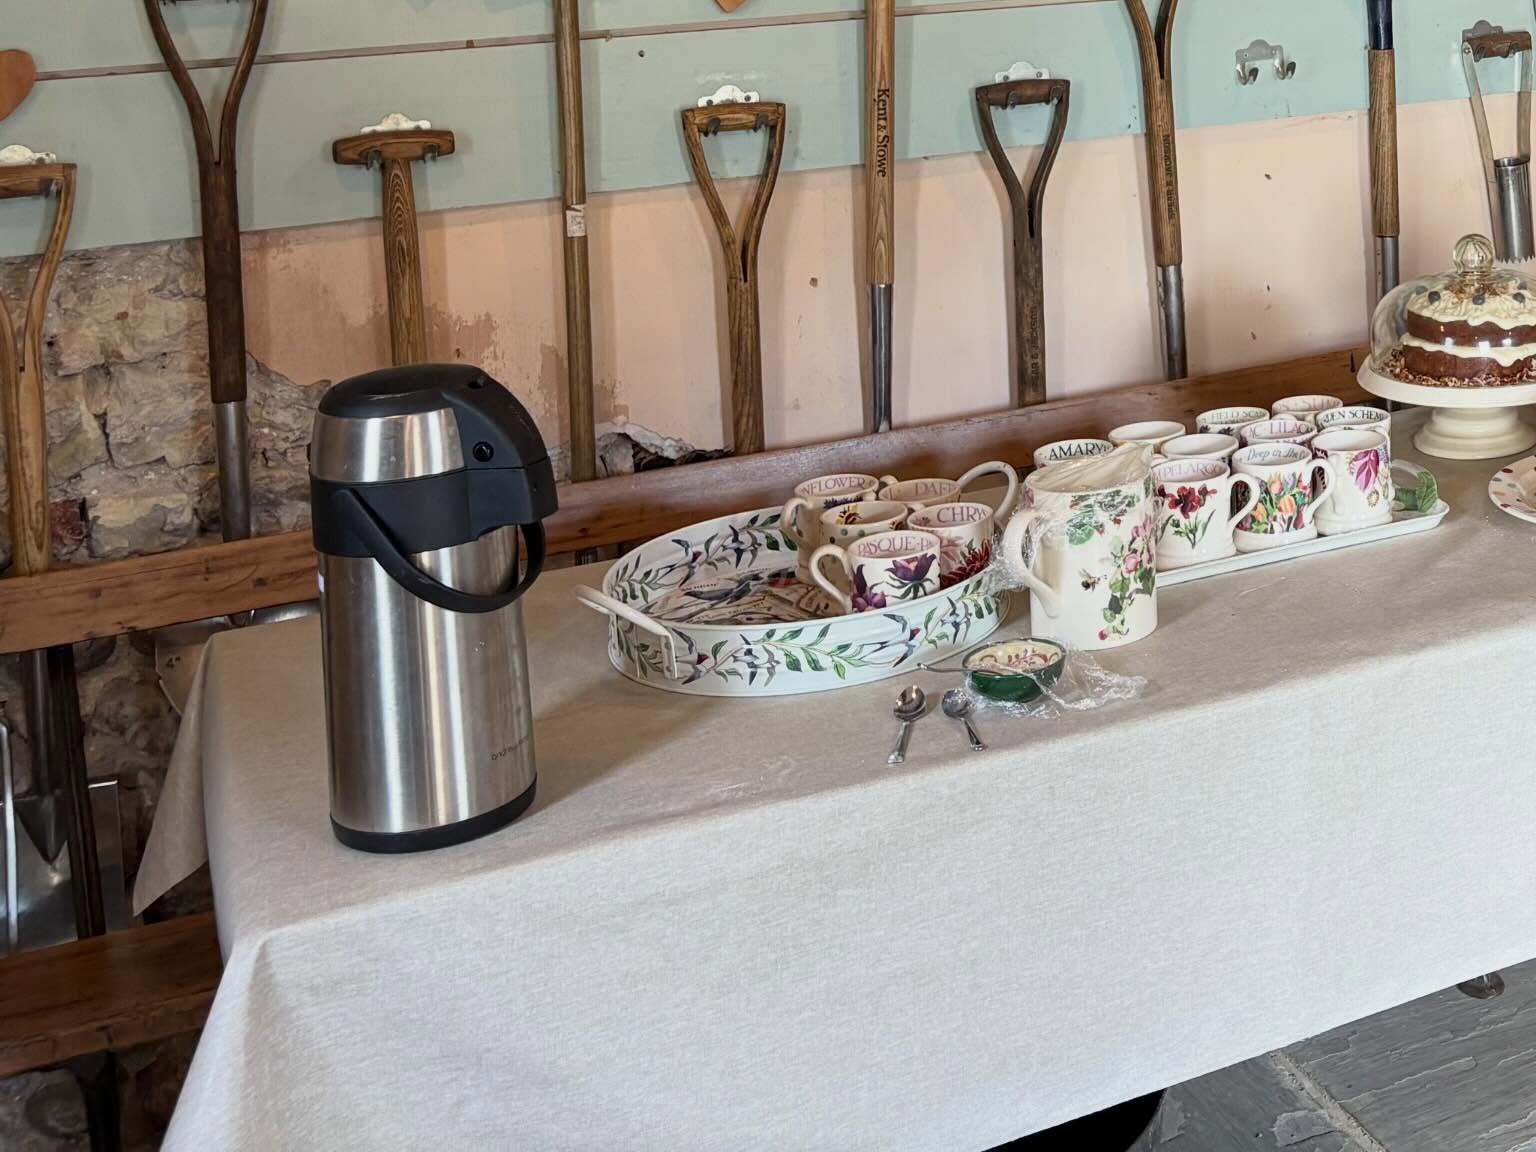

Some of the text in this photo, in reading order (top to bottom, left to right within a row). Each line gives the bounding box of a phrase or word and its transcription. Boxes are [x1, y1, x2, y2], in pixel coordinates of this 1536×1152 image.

[875, 87, 891, 178] Kent & Stowe
